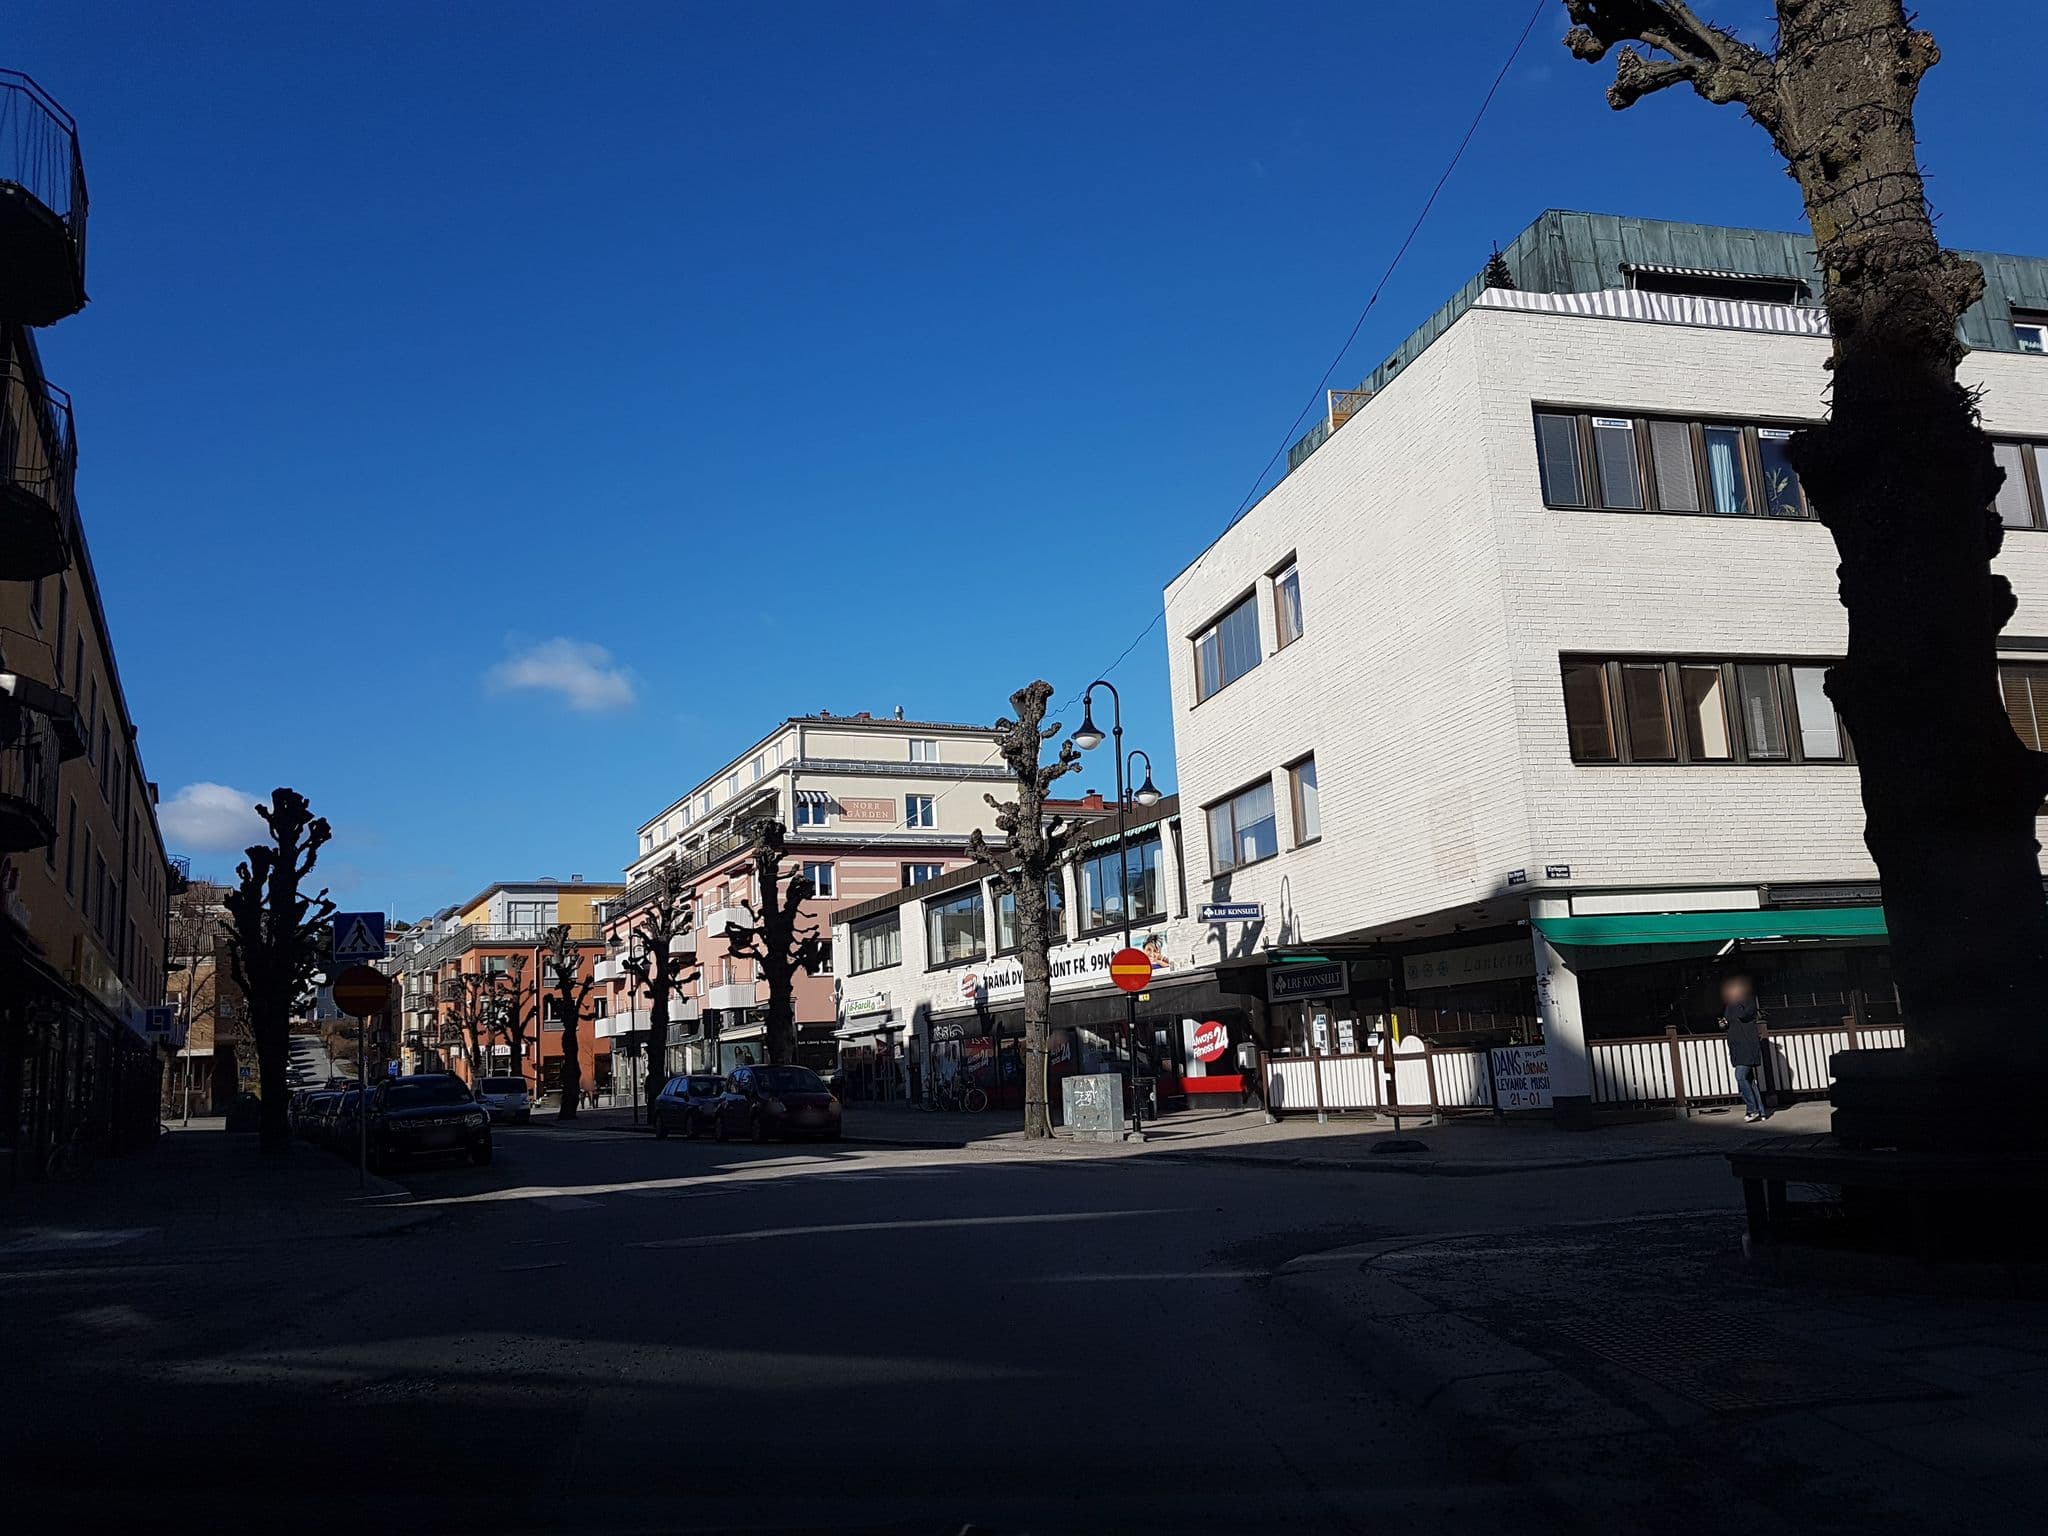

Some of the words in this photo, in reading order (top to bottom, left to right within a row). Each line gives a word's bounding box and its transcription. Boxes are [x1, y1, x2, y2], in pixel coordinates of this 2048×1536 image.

[1228, 907, 1258, 915] KONSULT
[983, 970, 1011, 990] TRÄNA
[1074, 957, 1089, 975] FR.
[1287, 977, 1301, 989] LRF
[1303, 971, 1341, 987] KONSULT
[1213, 1025, 1229, 1050] 24
[1493, 1050, 1522, 1076] DANS
[1496, 1077, 1529, 1091] LEVANDE
